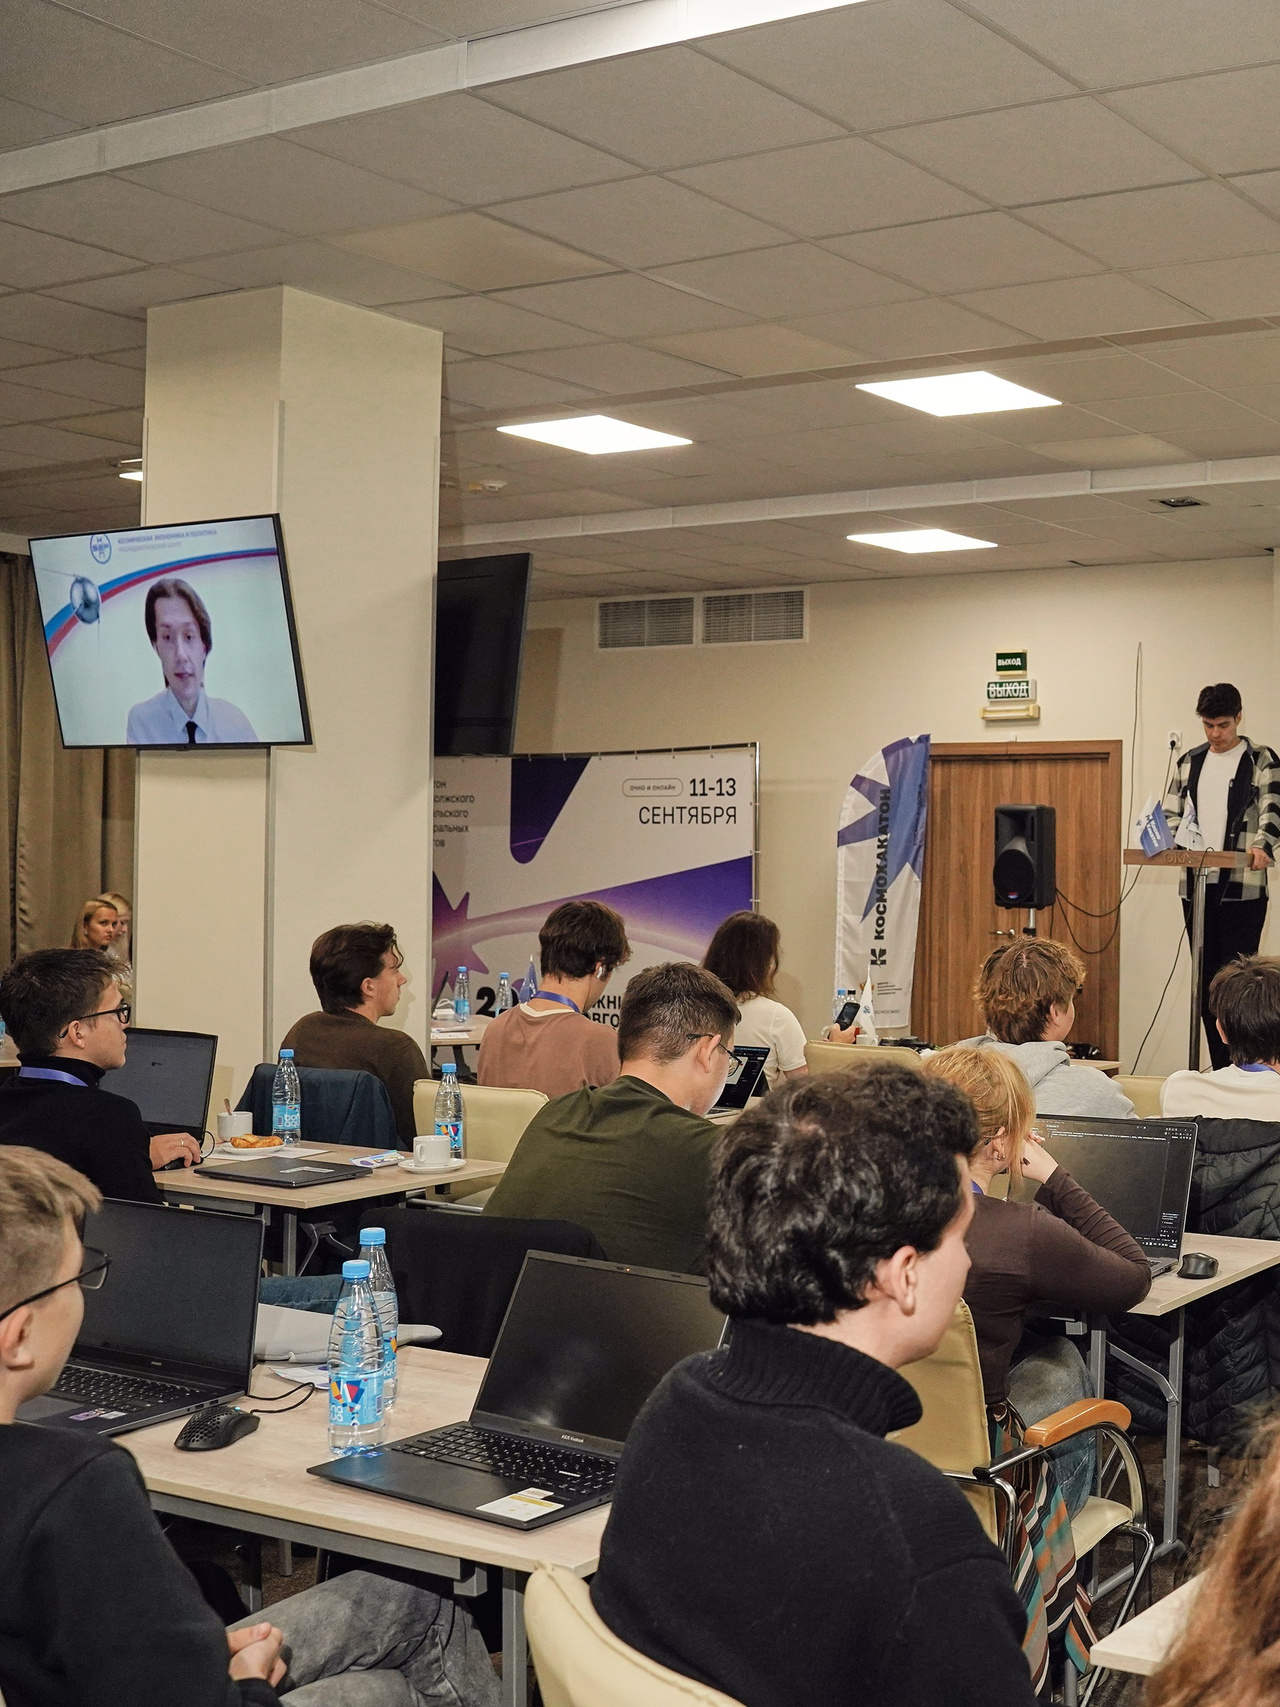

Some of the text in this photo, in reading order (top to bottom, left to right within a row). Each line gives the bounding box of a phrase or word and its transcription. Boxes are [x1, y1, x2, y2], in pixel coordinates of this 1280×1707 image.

[997, 658, 1022, 667] ВЫХОД
[988, 682, 1028, 698] ВЫХОД
[689, 778, 737, 797] 11-13
[638, 806, 737, 825] СЕНТЯБРЯ
[874, 788, 891, 940] КОСМОХАКАТОН
